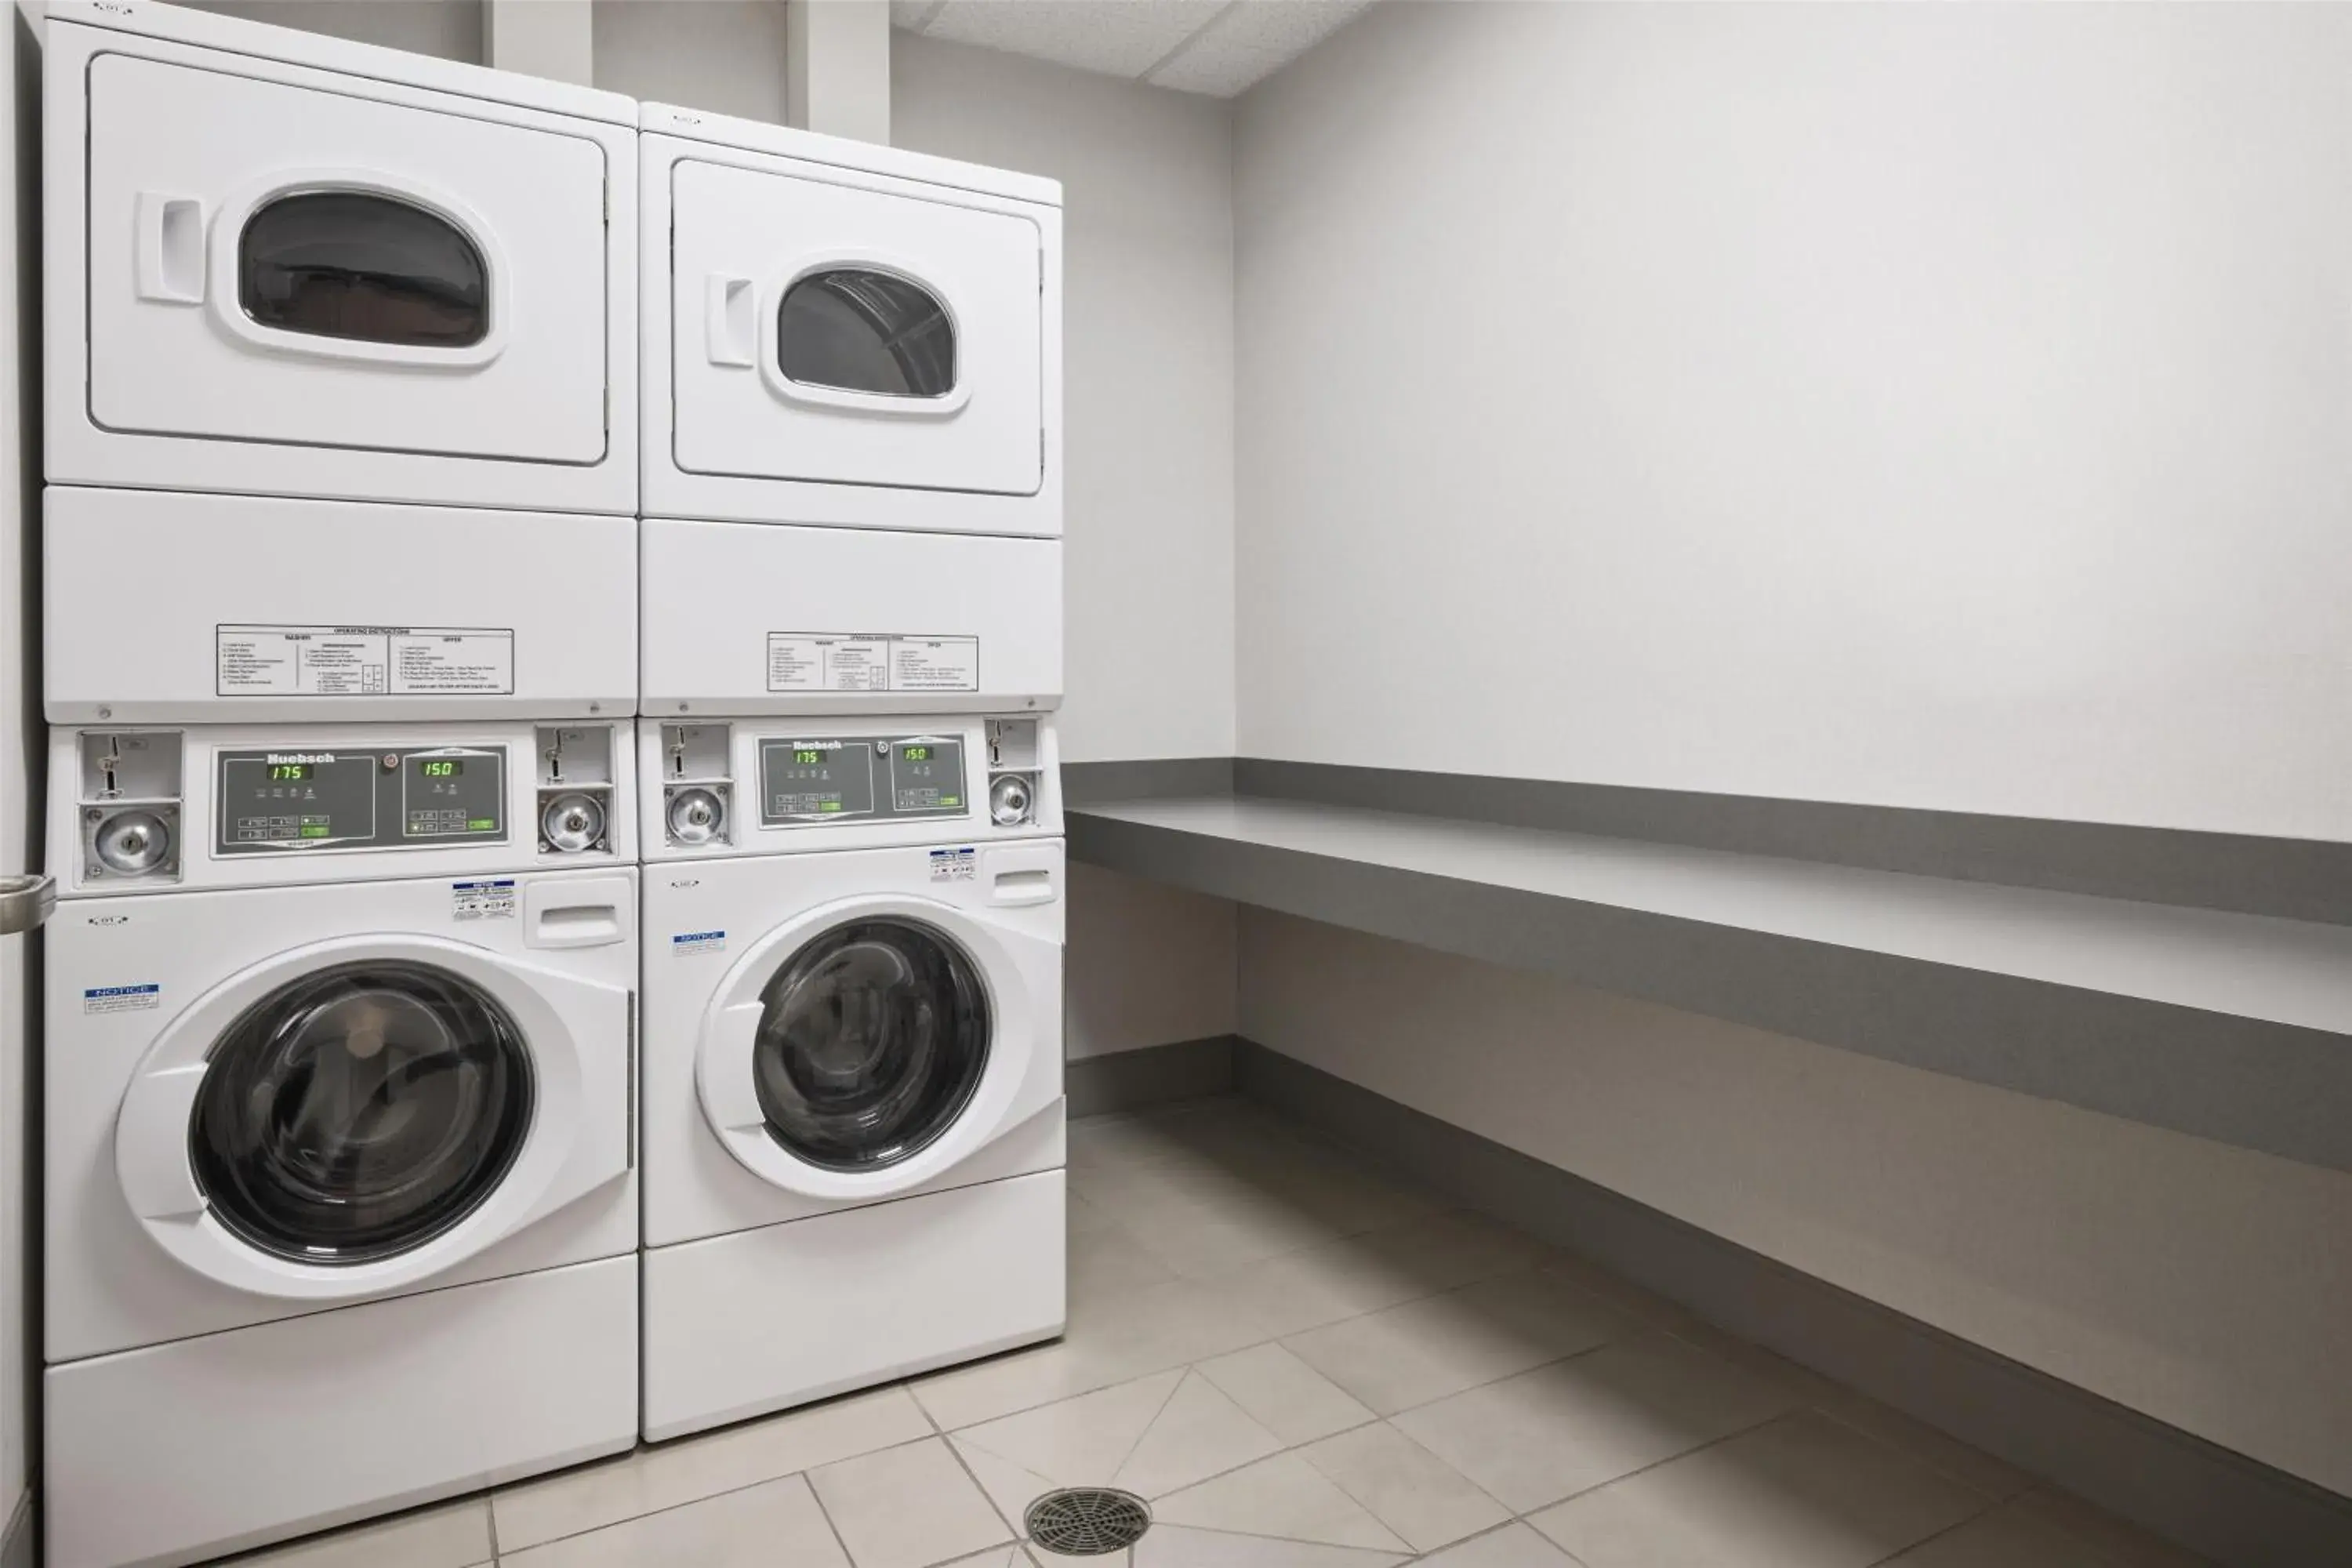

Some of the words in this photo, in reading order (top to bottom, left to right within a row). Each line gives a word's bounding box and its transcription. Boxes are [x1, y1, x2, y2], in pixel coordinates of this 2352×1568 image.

[267, 753, 336, 764] Huebsch
[797, 752, 817, 764] 175
[906, 749, 926, 760] 150
[273, 766, 302, 779] 175
[426, 763, 452, 775] 150
